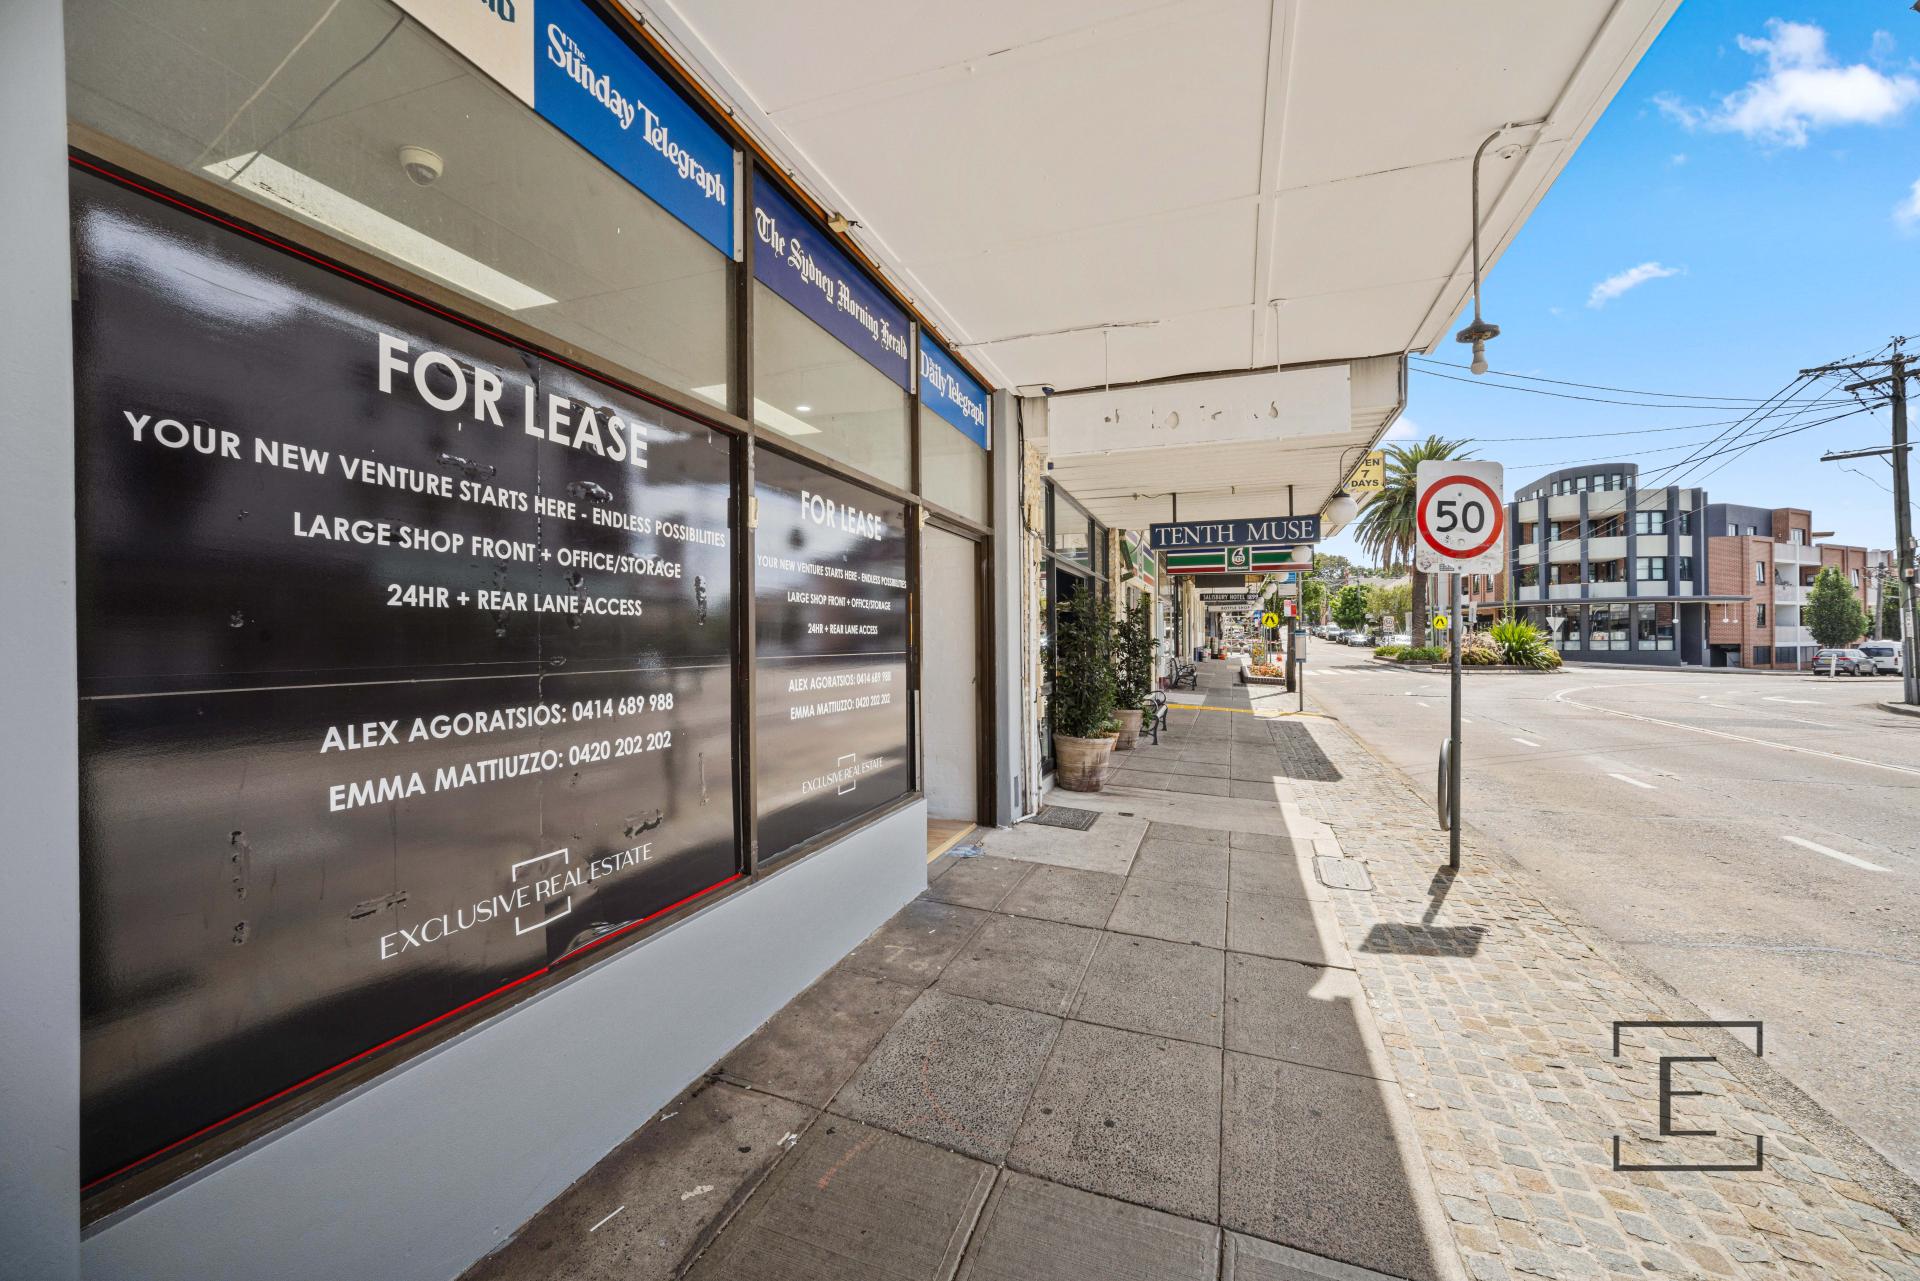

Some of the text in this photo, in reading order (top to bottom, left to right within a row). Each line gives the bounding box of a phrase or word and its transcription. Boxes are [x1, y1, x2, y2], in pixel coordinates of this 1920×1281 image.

[566, 36, 586, 62] The
[548, 24, 726, 206] Sunday Telegraph
[755, 207, 908, 360] The Sydney Morning Herald
[379, 332, 647, 469] FOR LEASE
[920, 349, 984, 426] Daily Telegraph
[123, 410, 241, 459] YOUR
[255, 437, 329, 474] NEW
[339, 454, 452, 498] VENTURE
[459, 481, 528, 512] STARTS
[534, 495, 576, 521] HERE
[592, 508, 651, 534] ENDLESS
[655, 523, 726, 547] POSSIBILITIES
[1361, 470, 1370, 478] 7
[1363, 459, 1380, 467] EN
[801, 490, 881, 541] FOR LEASE
[1436, 500, 1485, 533] 50
[294, 511, 681, 579] LARGE SHOP FRONT + OFFICE/STORAGE
[1155, 520, 1314, 546] TENTH MUSE
[757, 554, 778, 568] YOUR
[780, 559, 795, 571] NEW
[798, 562, 824, 576] VENTURE
[825, 566, 843, 579] STARTS
[845, 570, 857, 581] HERE
[862, 573, 880, 585] ENDLESS
[387, 584, 642, 616] 24HR + REAR LANE ACCESS
[788, 592, 809, 603] LARGE
[810, 594, 827, 605] SHOP
[828, 596, 845, 607] FRONT
[852, 598, 891, 611] OFFICE/STORAGE
[808, 623, 823, 634] 24HR
[830, 624, 843, 634] REAR
[845, 625, 858, 634] LANE
[859, 625, 878, 635] ACCESS
[788, 679, 808, 692] ALEX
[810, 674, 855, 690] AGORATSIOS:
[856, 673, 870, 685] 0414
[320, 693, 674, 753] ALEX AGORATSIOS: 0414 689 988
[790, 693, 891, 720] EMMA MATTIUZZO: 0420 202 202
[329, 731, 671, 812] EMMA MATTIUZZO: 0420 202 202
[802, 757, 883, 793] EXCLUSIVE REAL ESTATE
[381, 843, 652, 960] EXCLUSIVE REAL ESTATE
